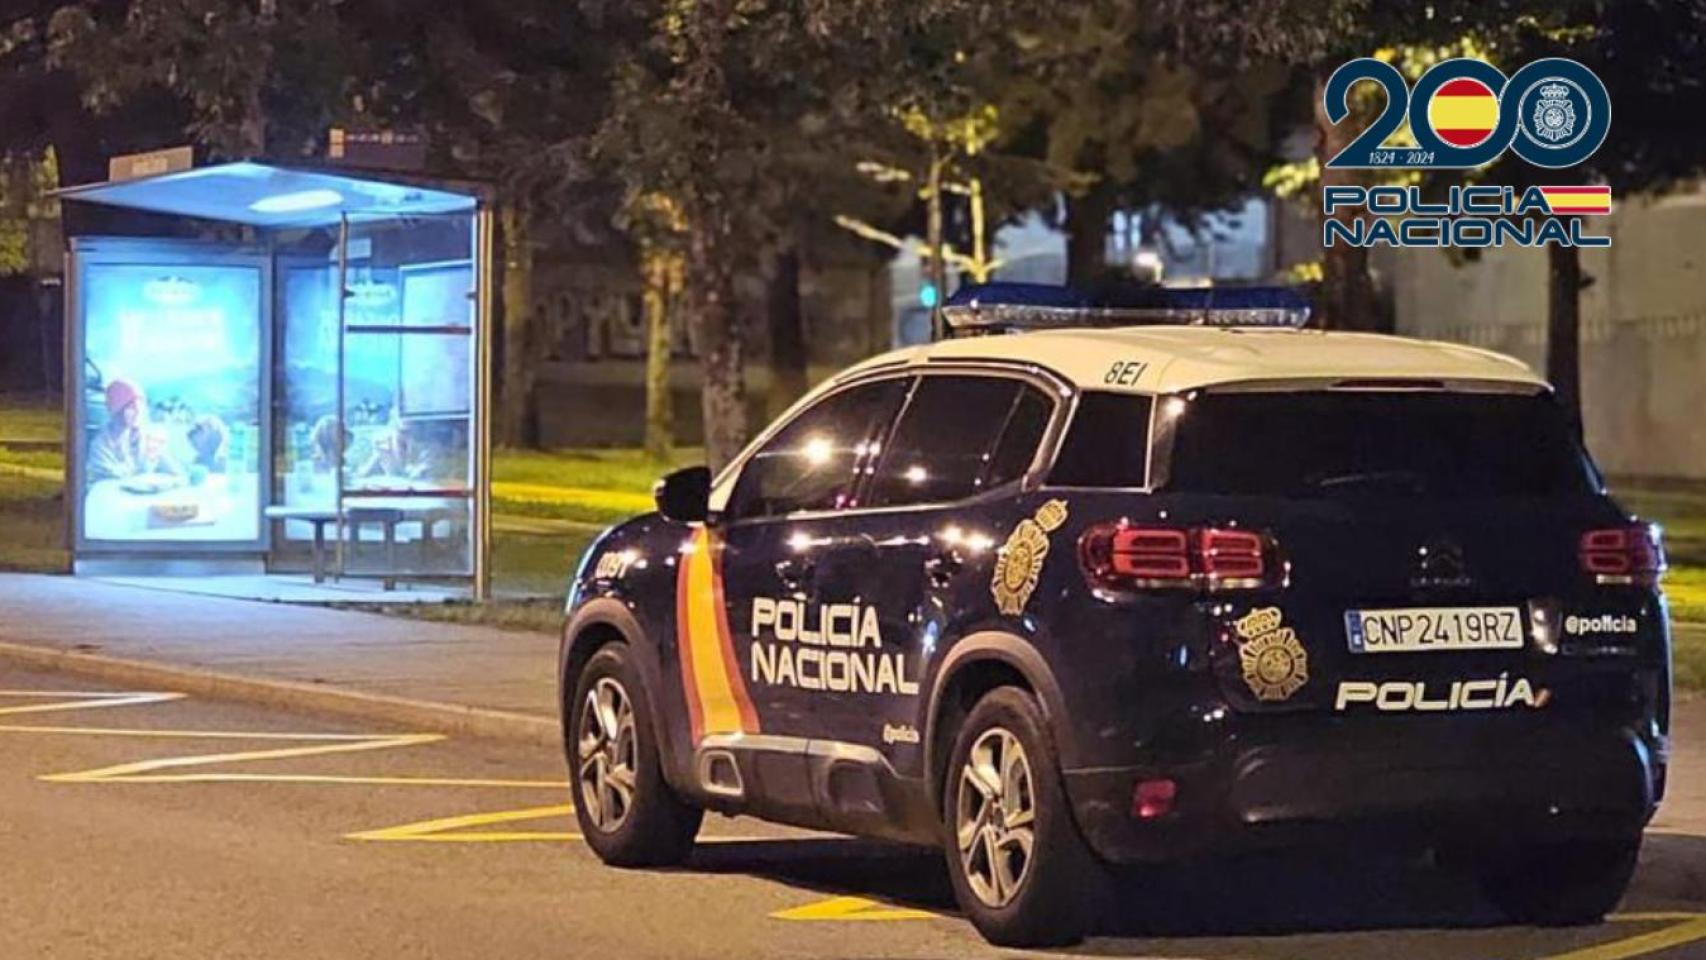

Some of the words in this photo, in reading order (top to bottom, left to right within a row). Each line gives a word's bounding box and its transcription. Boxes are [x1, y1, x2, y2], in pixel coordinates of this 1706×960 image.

[752, 595, 881, 648] POLICÍA
[752, 641, 919, 694] NACIONAL
[1335, 672, 1534, 710] POLICÍA
